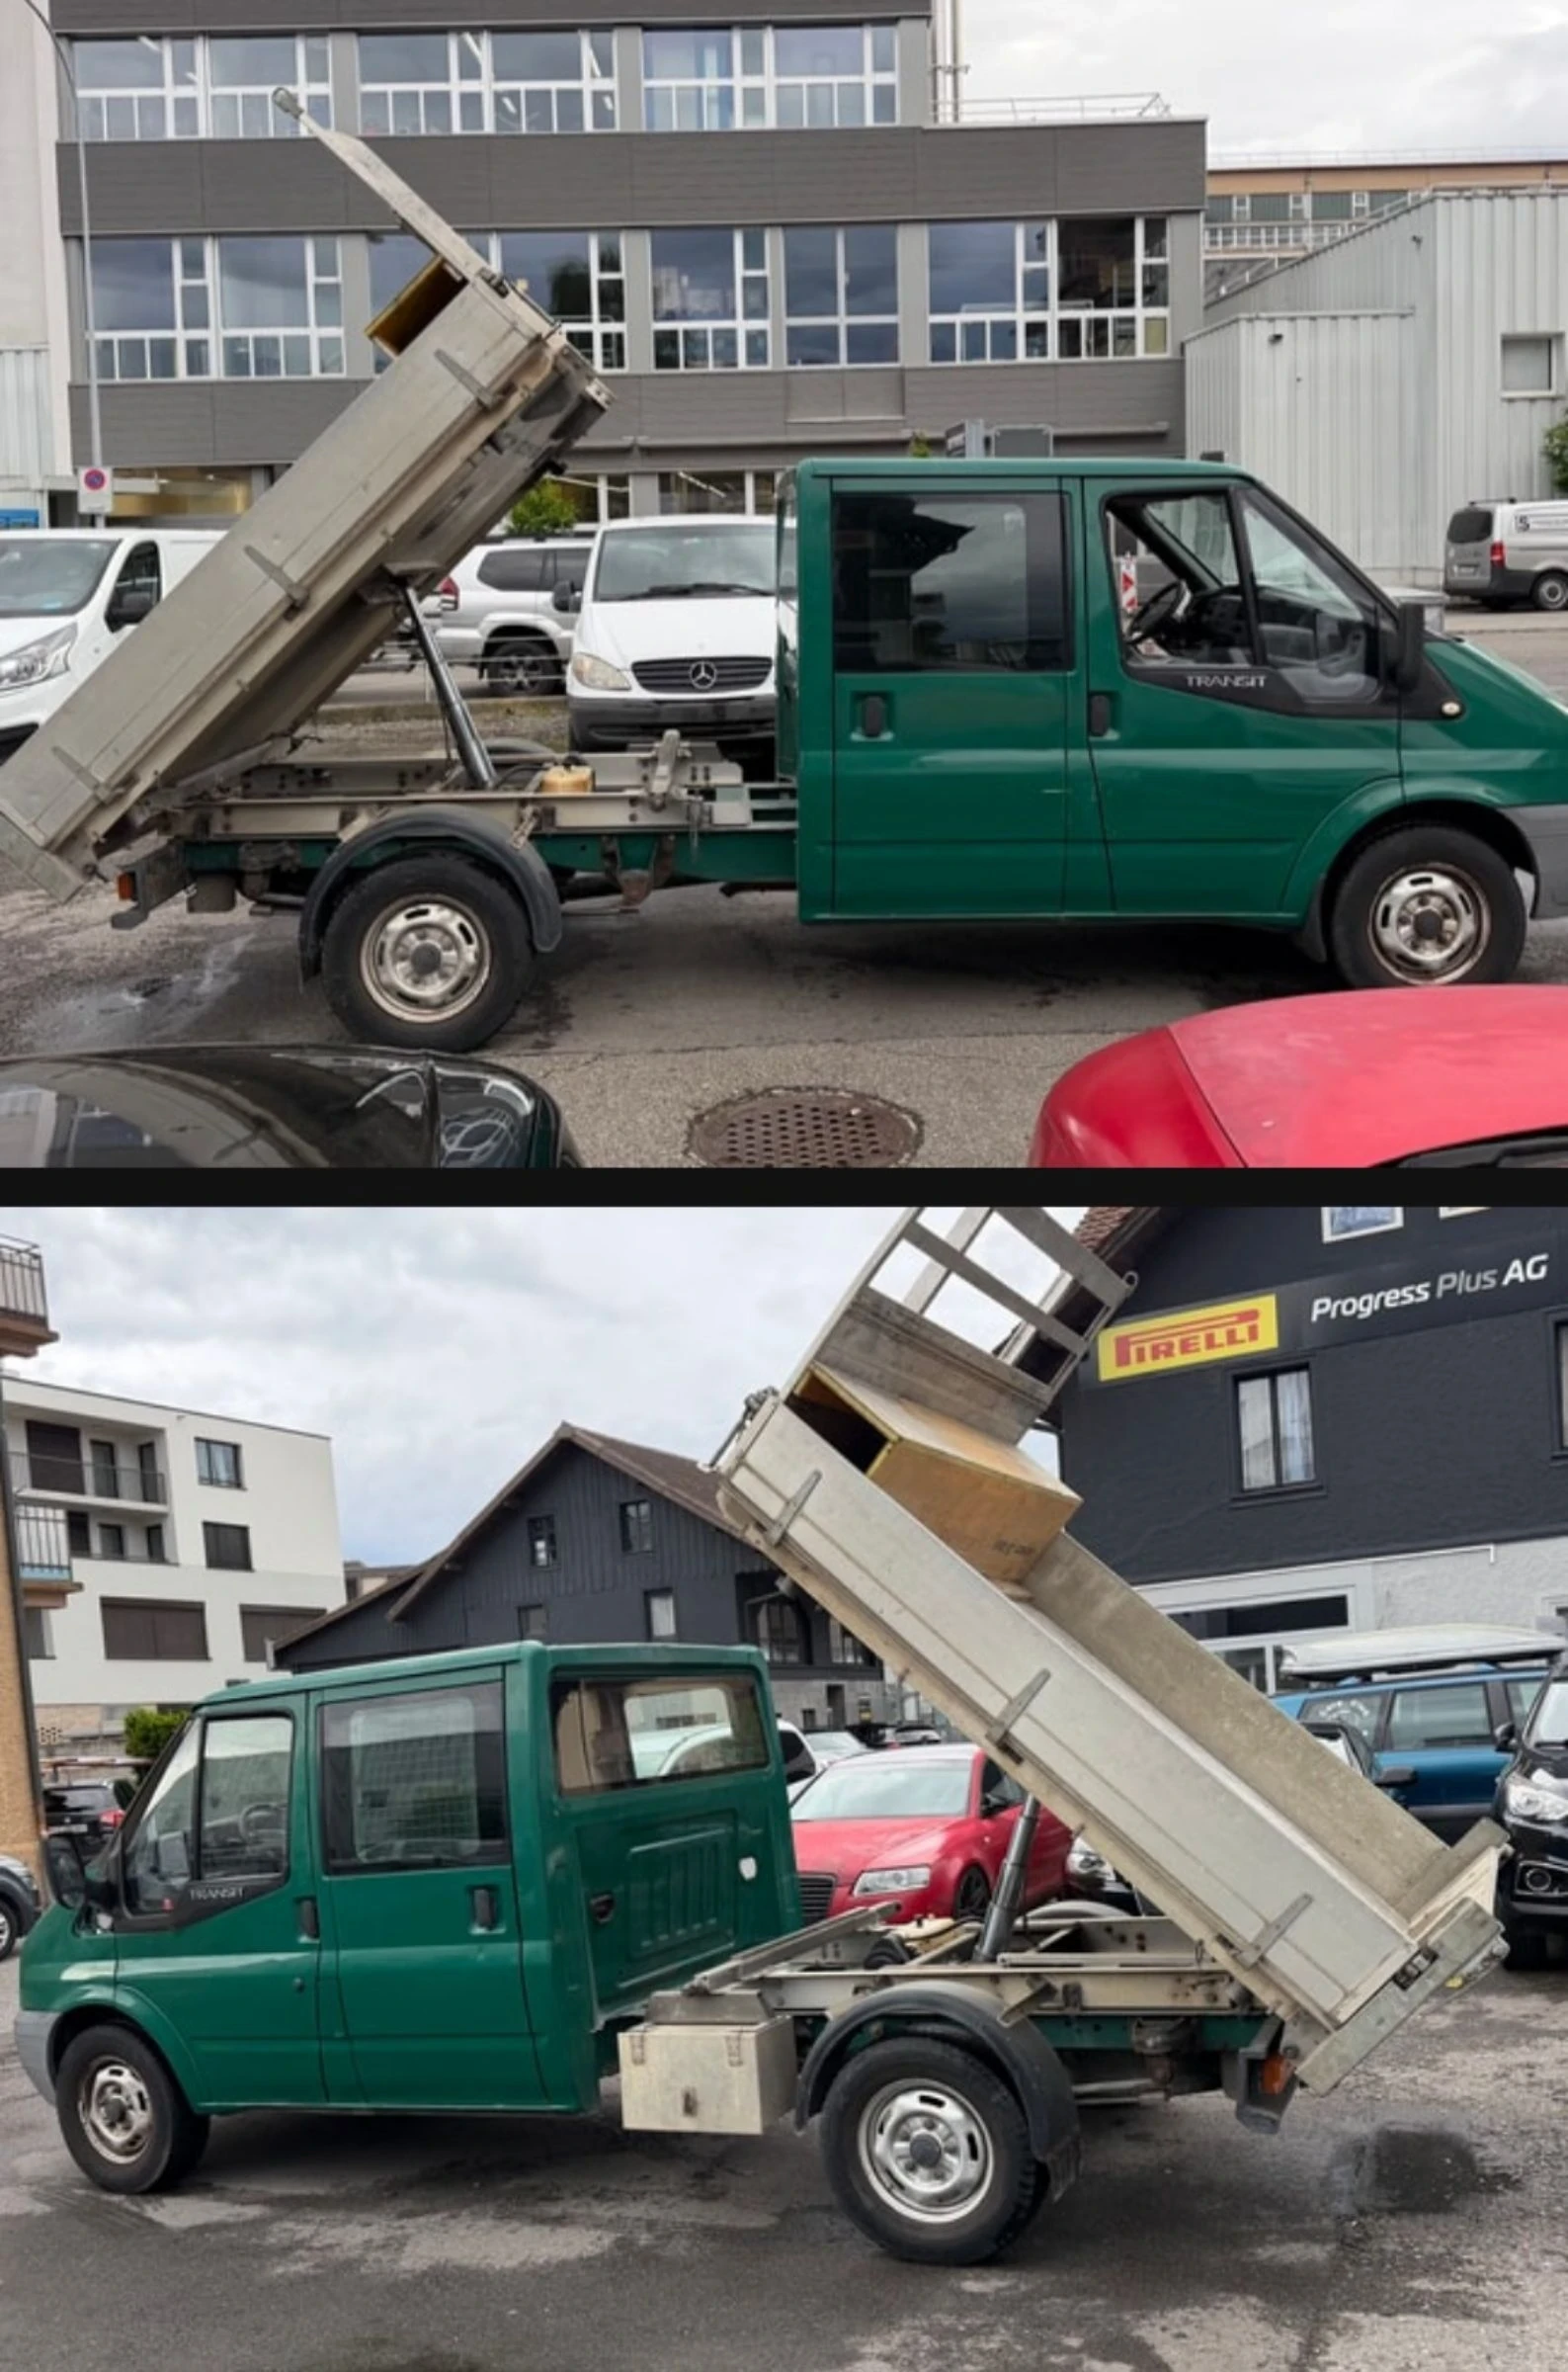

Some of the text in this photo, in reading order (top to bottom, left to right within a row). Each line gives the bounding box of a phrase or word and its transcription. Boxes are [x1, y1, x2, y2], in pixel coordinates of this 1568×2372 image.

[1186, 675, 1267, 688] TRANSIT
[1310, 1253, 1549, 1322] Progress Plus AG
[1113, 1308, 1261, 1369] PIRELLI
